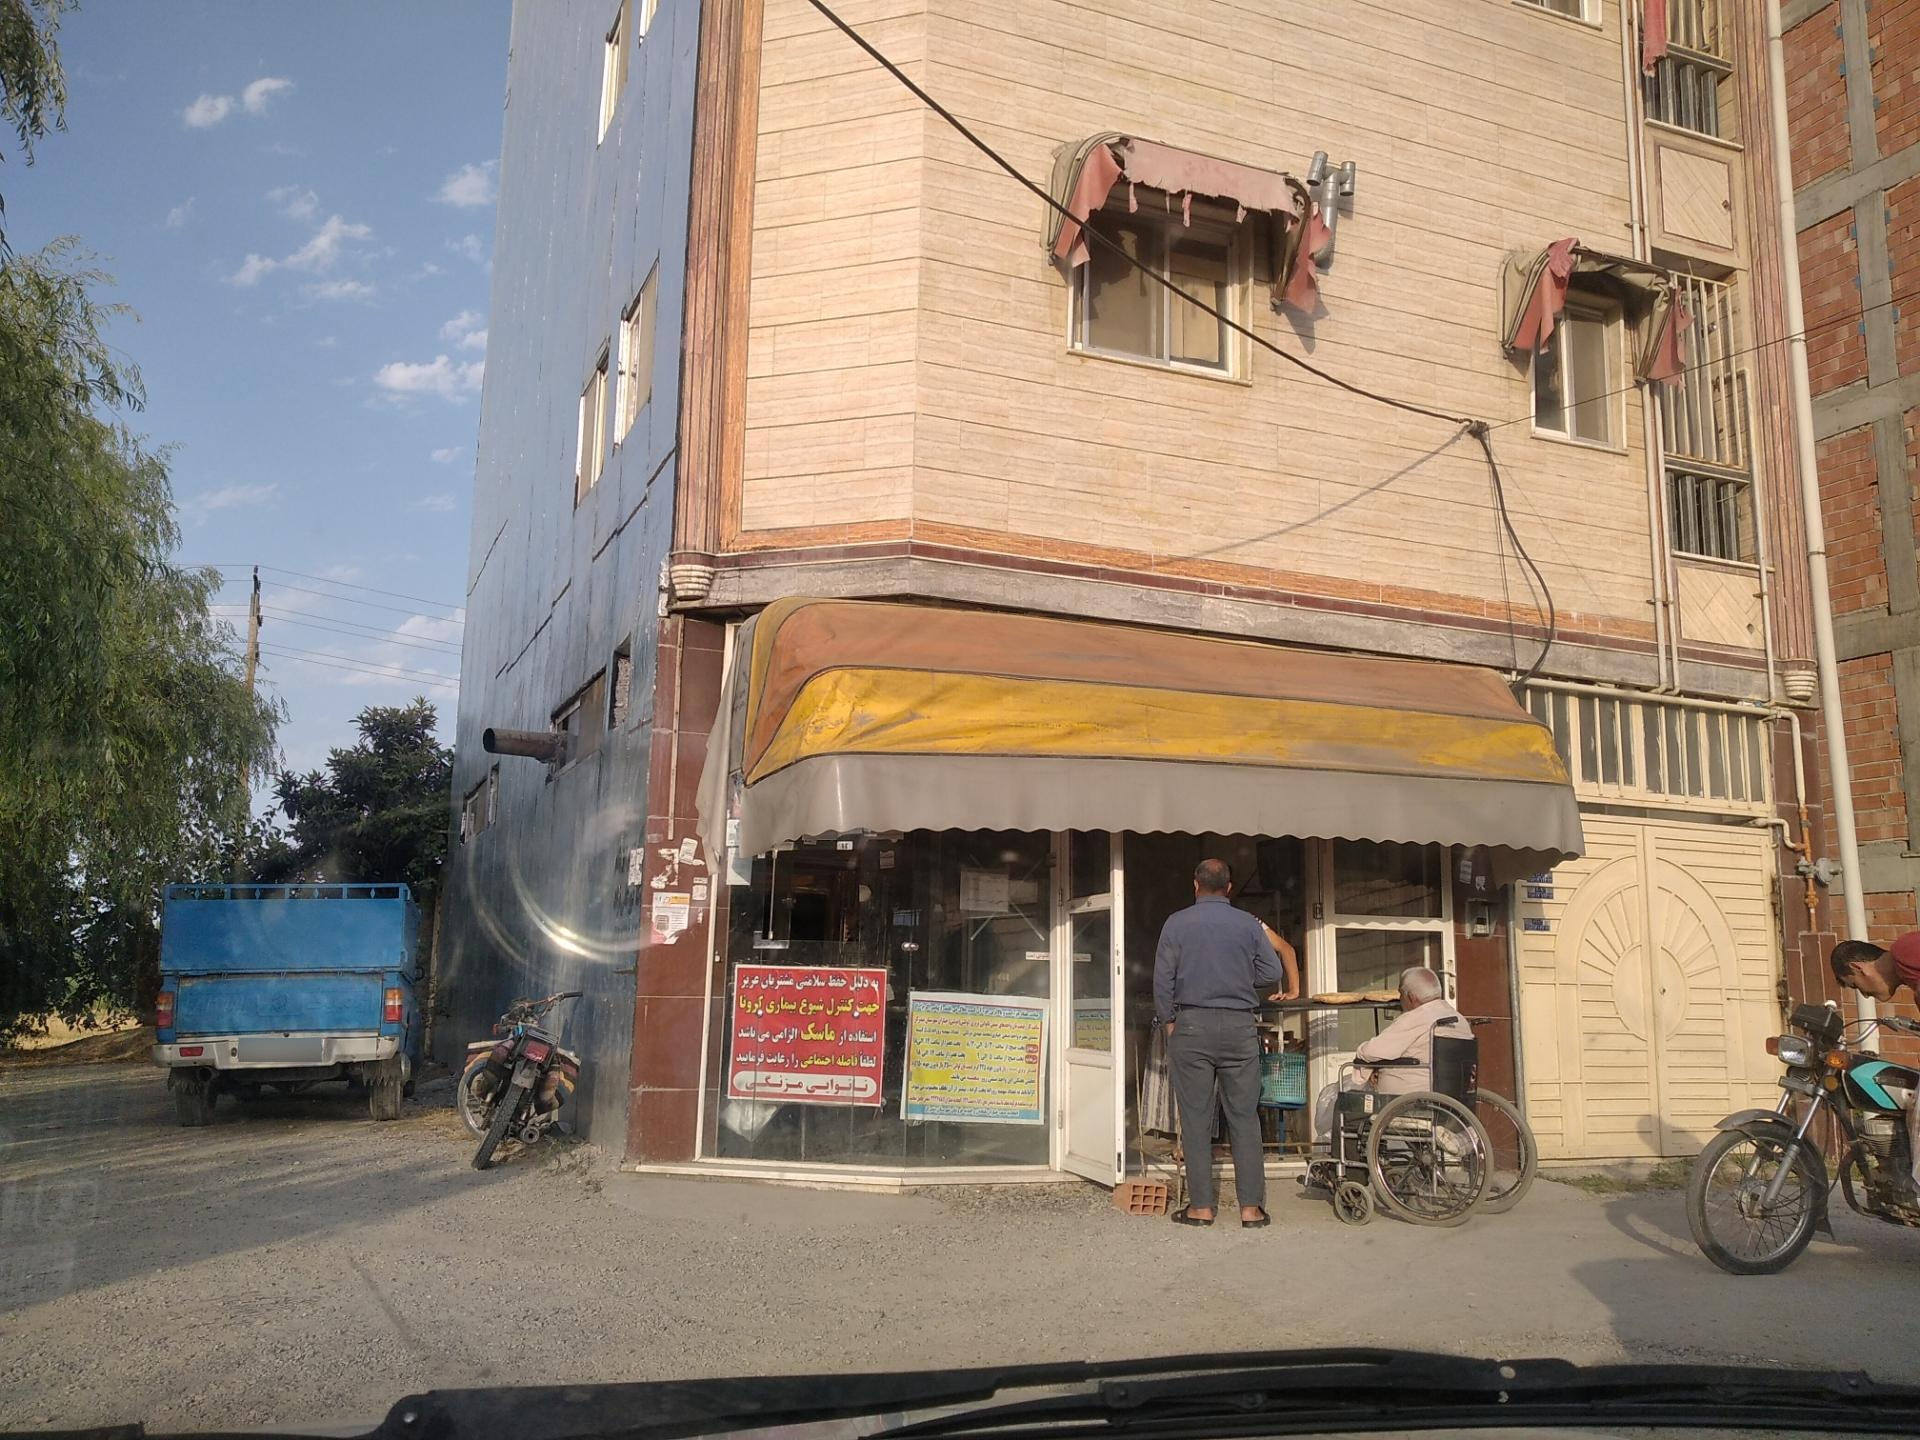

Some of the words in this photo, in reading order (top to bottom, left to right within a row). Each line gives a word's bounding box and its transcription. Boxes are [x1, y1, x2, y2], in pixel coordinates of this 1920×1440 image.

[741, 974, 759, 989] عزیز
[760, 973, 794, 990] مشتریان
[795, 974, 826, 990] سلامتی
[828, 974, 847, 988] حفظ
[849, 975, 869, 991] دلیل
[870, 980, 879, 991] به
[739, 994, 764, 1014] کرونا
[765, 996, 797, 1014] بیماری
[799, 998, 824, 1016] شیوع
[826, 998, 854, 1016] کنترل
[857, 999, 880, 1016] جهت
[738, 1026, 756, 1039] باشد
[757, 1031, 770, 1043] می
[771, 1028, 798, 1043] الزامی
[800, 1022, 835, 1041] ماسک
[838, 1030, 847, 1045] از
[848, 1030, 877, 1043] استفاده
[735, 1050, 765, 1066] فرمایید
[766, 1052, 790, 1068] رعایت
[791, 1054, 799, 1068] را
[800, 1055, 834, 1069] اجتماعی
[836, 1055, 858, 1067] فاصله
[745, 1075, 804, 1092] مزنگی
[806, 1078, 868, 1095] نانوایی
